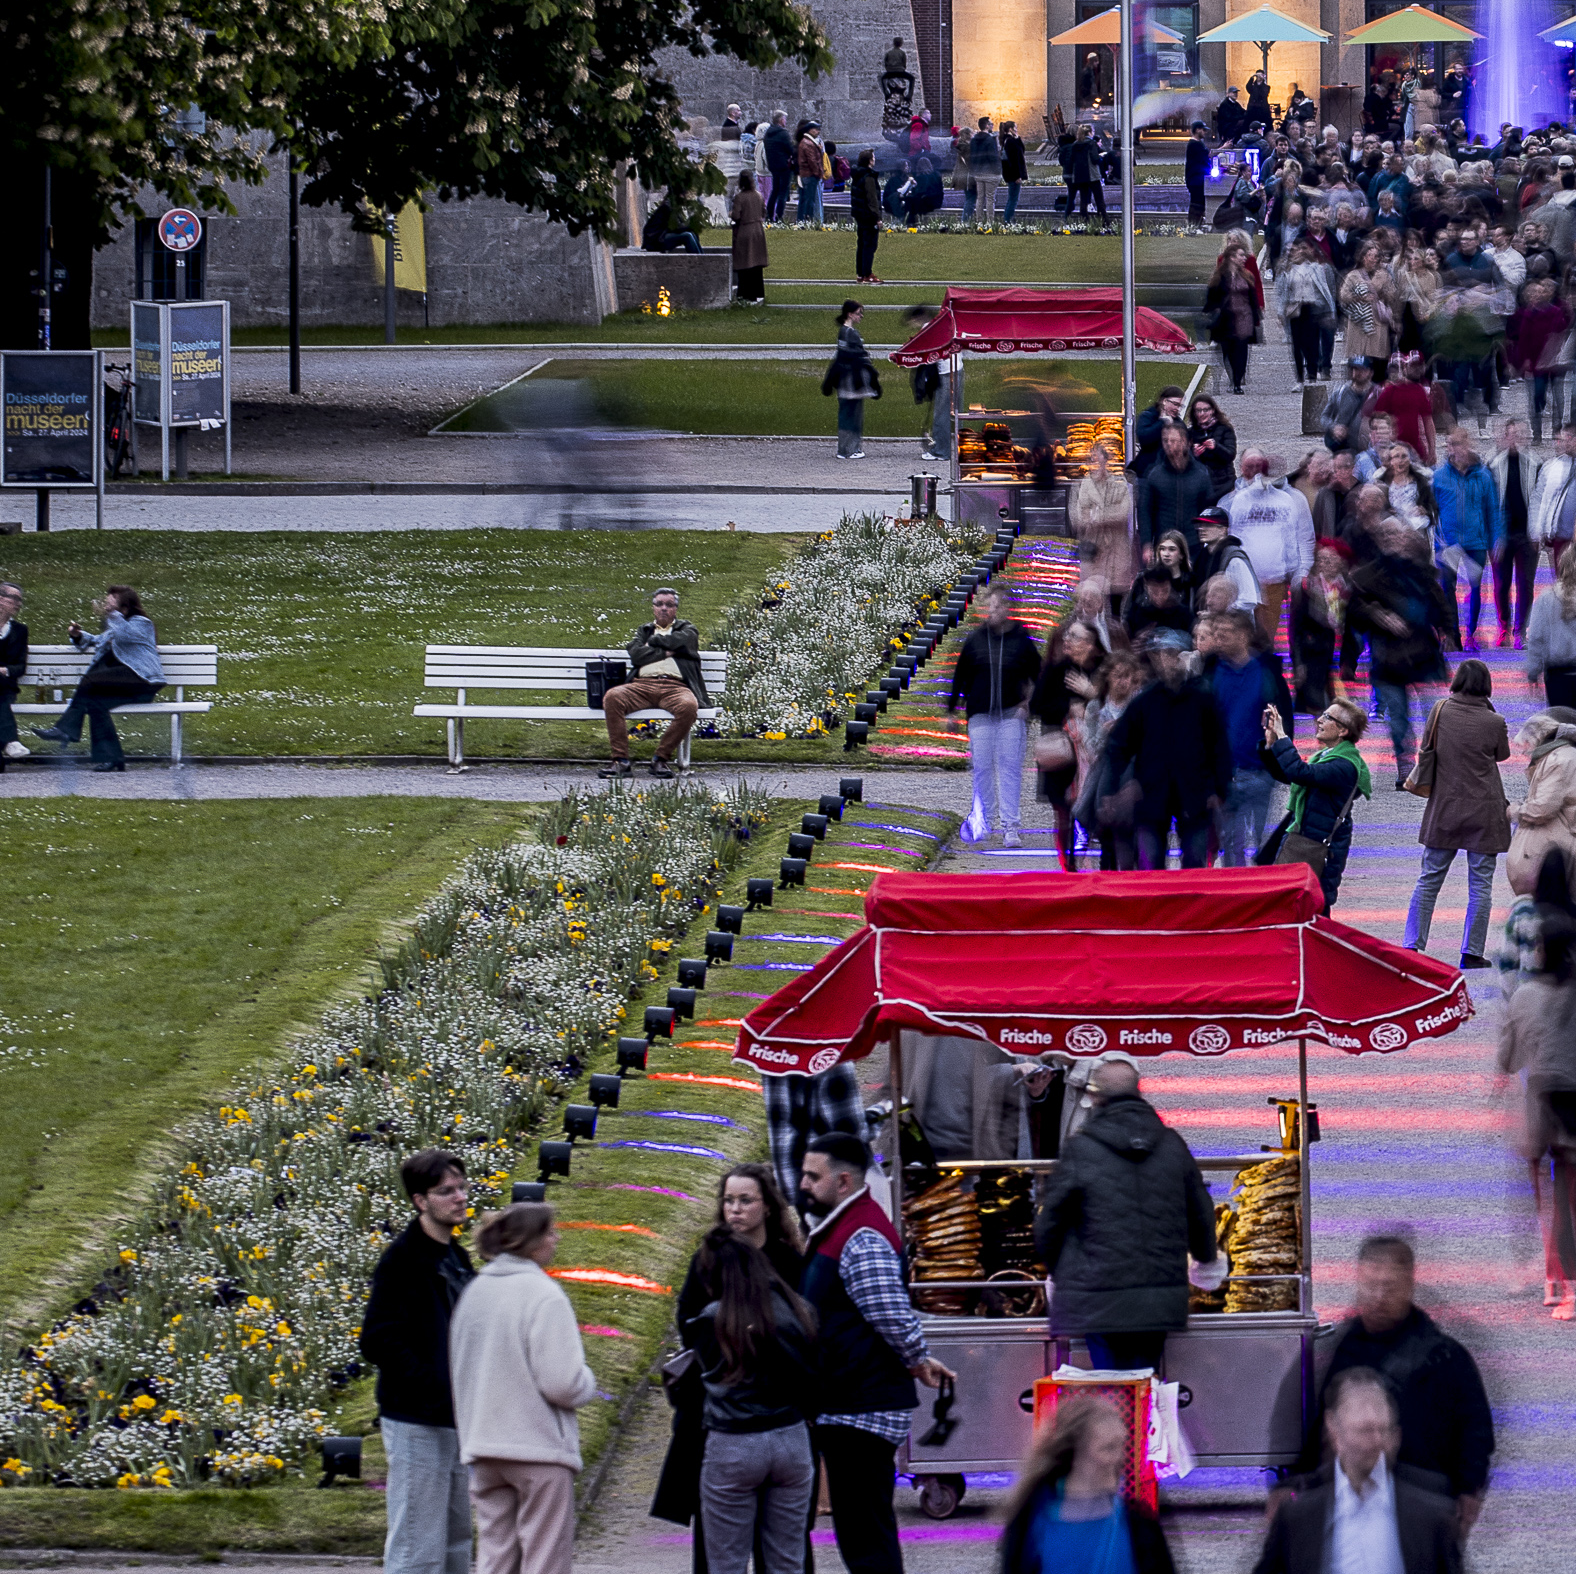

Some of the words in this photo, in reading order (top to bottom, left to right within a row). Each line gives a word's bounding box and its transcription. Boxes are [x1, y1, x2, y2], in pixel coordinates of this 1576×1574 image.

[172, 339, 221, 353] Düsseldorfer
[1072, 340, 1096, 348] Frische
[172, 351, 194, 361] nacht
[195, 350, 208, 359] der
[902, 355, 923, 363] Frische
[172, 358, 221, 374] museen
[6, 392, 88, 404] Düsseldorfer
[6, 403, 41, 414] nacht
[44, 403, 65, 414] der
[6, 414, 88, 429] museen
[50, 429, 69, 438] April
[1414, 1006, 1462, 1034] Frische
[1000, 1028, 1052, 1045] Frische
[1119, 1028, 1173, 1045] Frische
[748, 1043, 800, 1066] Frische
